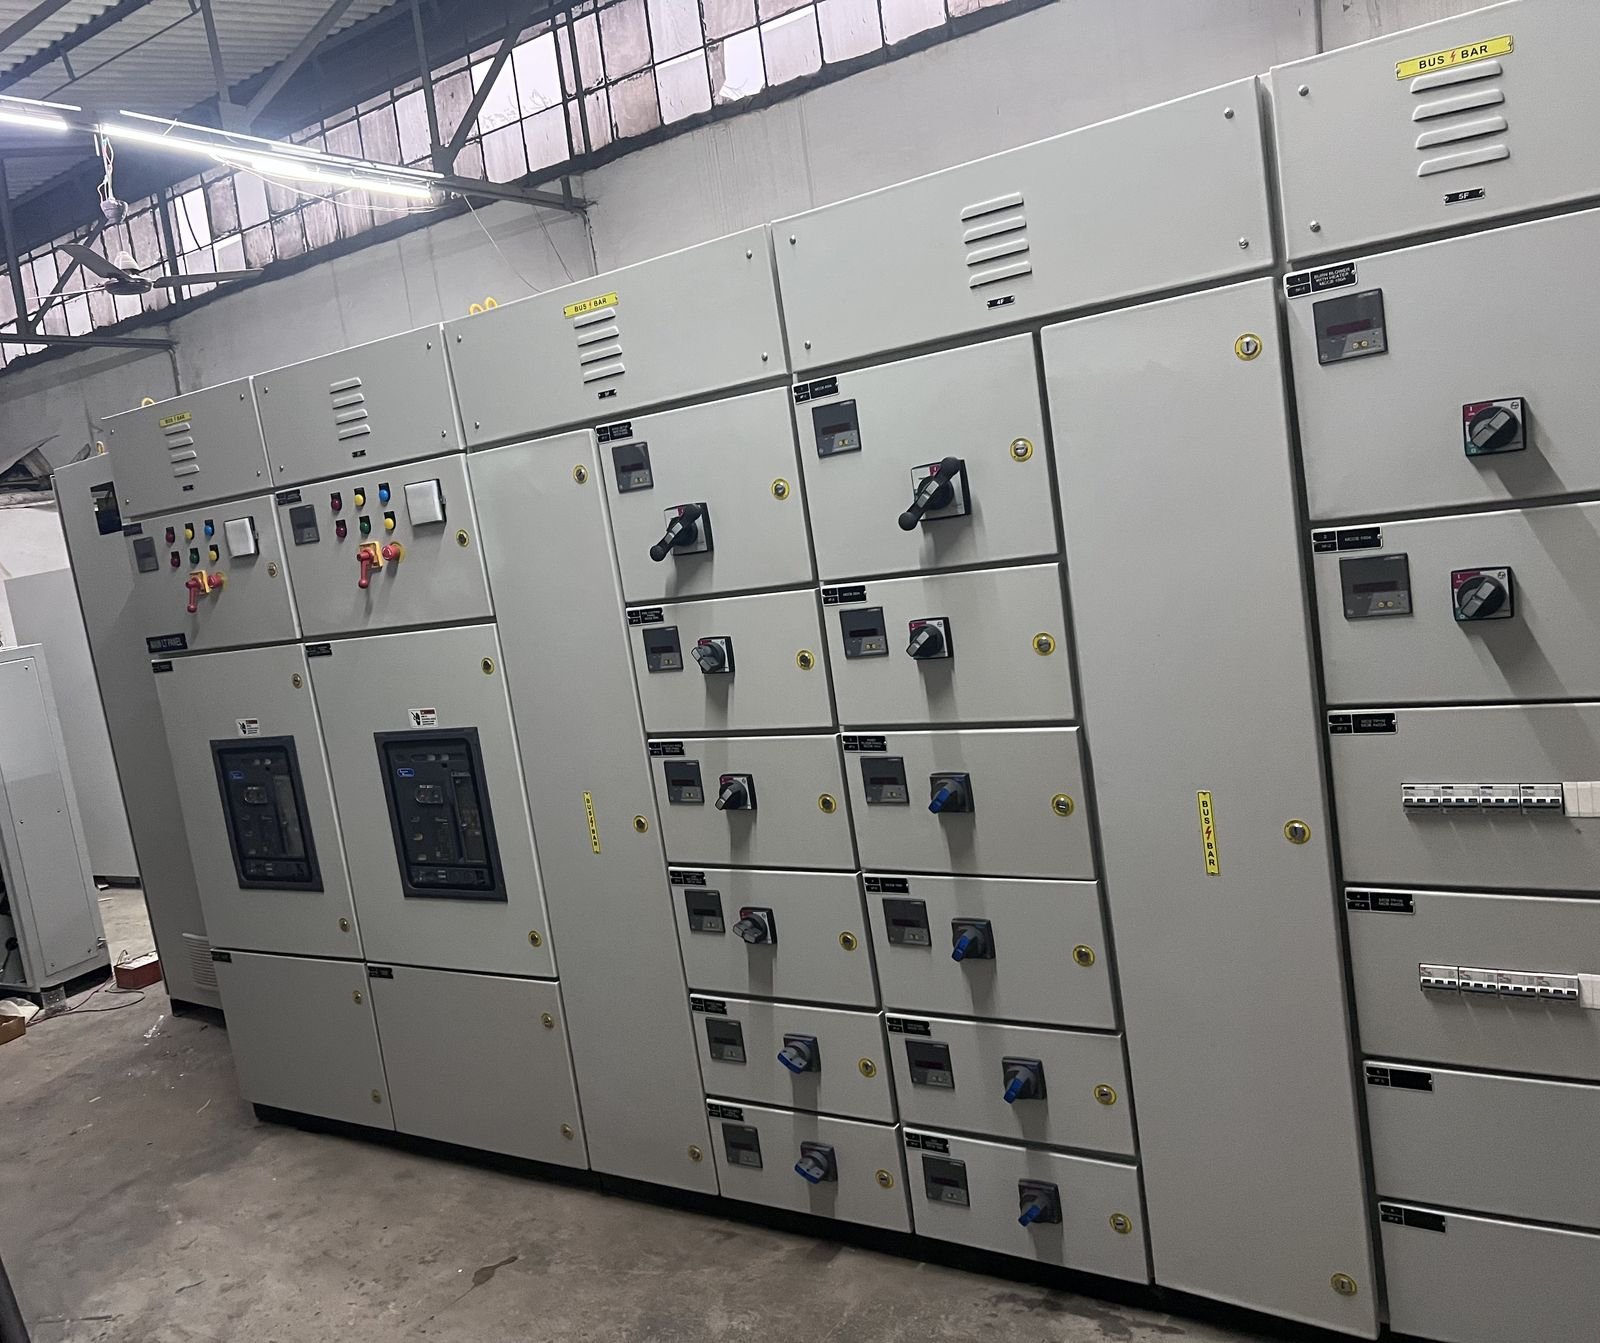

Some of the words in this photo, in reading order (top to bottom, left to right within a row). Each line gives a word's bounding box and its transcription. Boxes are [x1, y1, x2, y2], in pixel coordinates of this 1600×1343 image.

[1418, 55, 1445, 70] BUS
[1461, 44, 1489, 59] BAR
[574, 303, 587, 313] BUS
[593, 297, 607, 307] BAR
[1201, 800, 1211, 825] BUS
[1206, 842, 1216, 866] BAR
